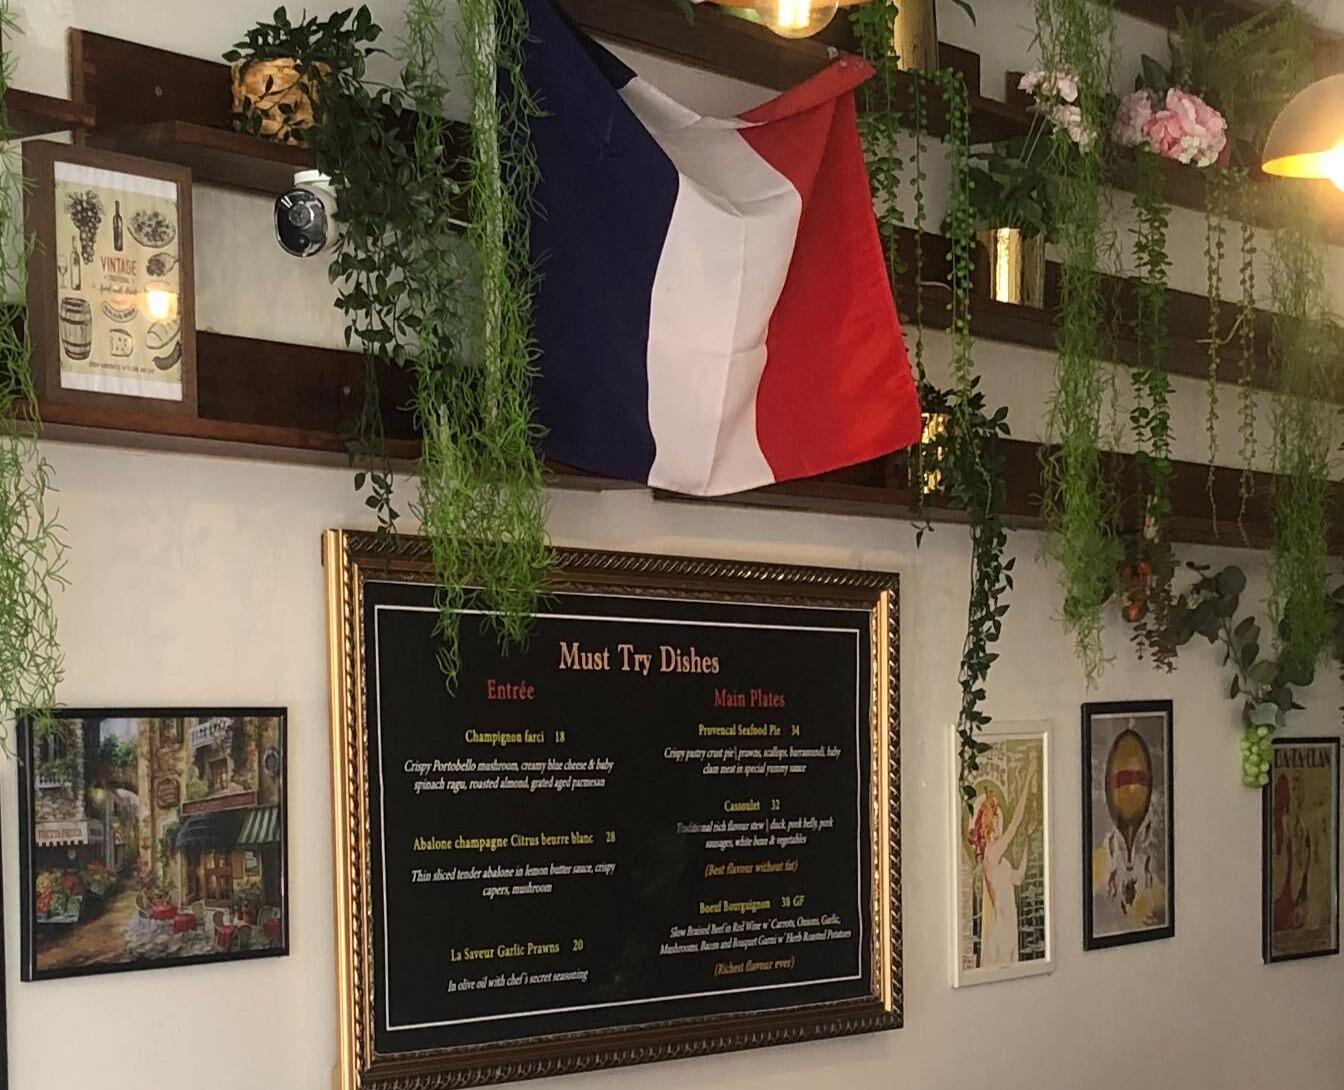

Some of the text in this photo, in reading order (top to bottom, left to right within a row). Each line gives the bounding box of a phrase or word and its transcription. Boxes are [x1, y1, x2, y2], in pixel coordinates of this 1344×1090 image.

[100, 257, 136, 276] VINTAGE
[559, 642, 720, 679] Must Try Dishes
[488, 679, 535, 699] Entrée
[714, 688, 785, 707] Main Plates
[465, 730, 565, 746] Champignon farci 18
[738, 724, 767, 736] Seafood
[769, 725, 781, 736] Pie
[791, 725, 800, 736] 34
[405, 759, 432, 776] Crispy
[432, 759, 476, 772] Portobello
[564, 759, 586, 770] cheese
[588, 759, 595, 770] &
[414, 777, 445, 792] spinach
[470, 777, 498, 789] roasted
[554, 776, 571, 791] aged
[771, 799, 780, 810] 32
[413, 831, 615, 852] Abalone champagne Citrus beurre blanc 28
[411, 870, 431, 882] Thin
[433, 867, 456, 881] sliced
[457, 866, 482, 879] tender
[483, 865, 514, 878] abalone
[515, 865, 523, 877] in
[525, 863, 548, 876] lemon
[483, 882, 552, 899] capers, mushroom
[793, 896, 804, 907] GF
[450, 939, 583, 962] La Saveur Garlic Prawns 20
[448, 980, 456, 992] In
[458, 977, 475, 990] olive
[477, 976, 487, 989] oil
[488, 974, 505, 988] with
[530, 971, 552, 983] secret
[553, 969, 588, 982] seasoning
